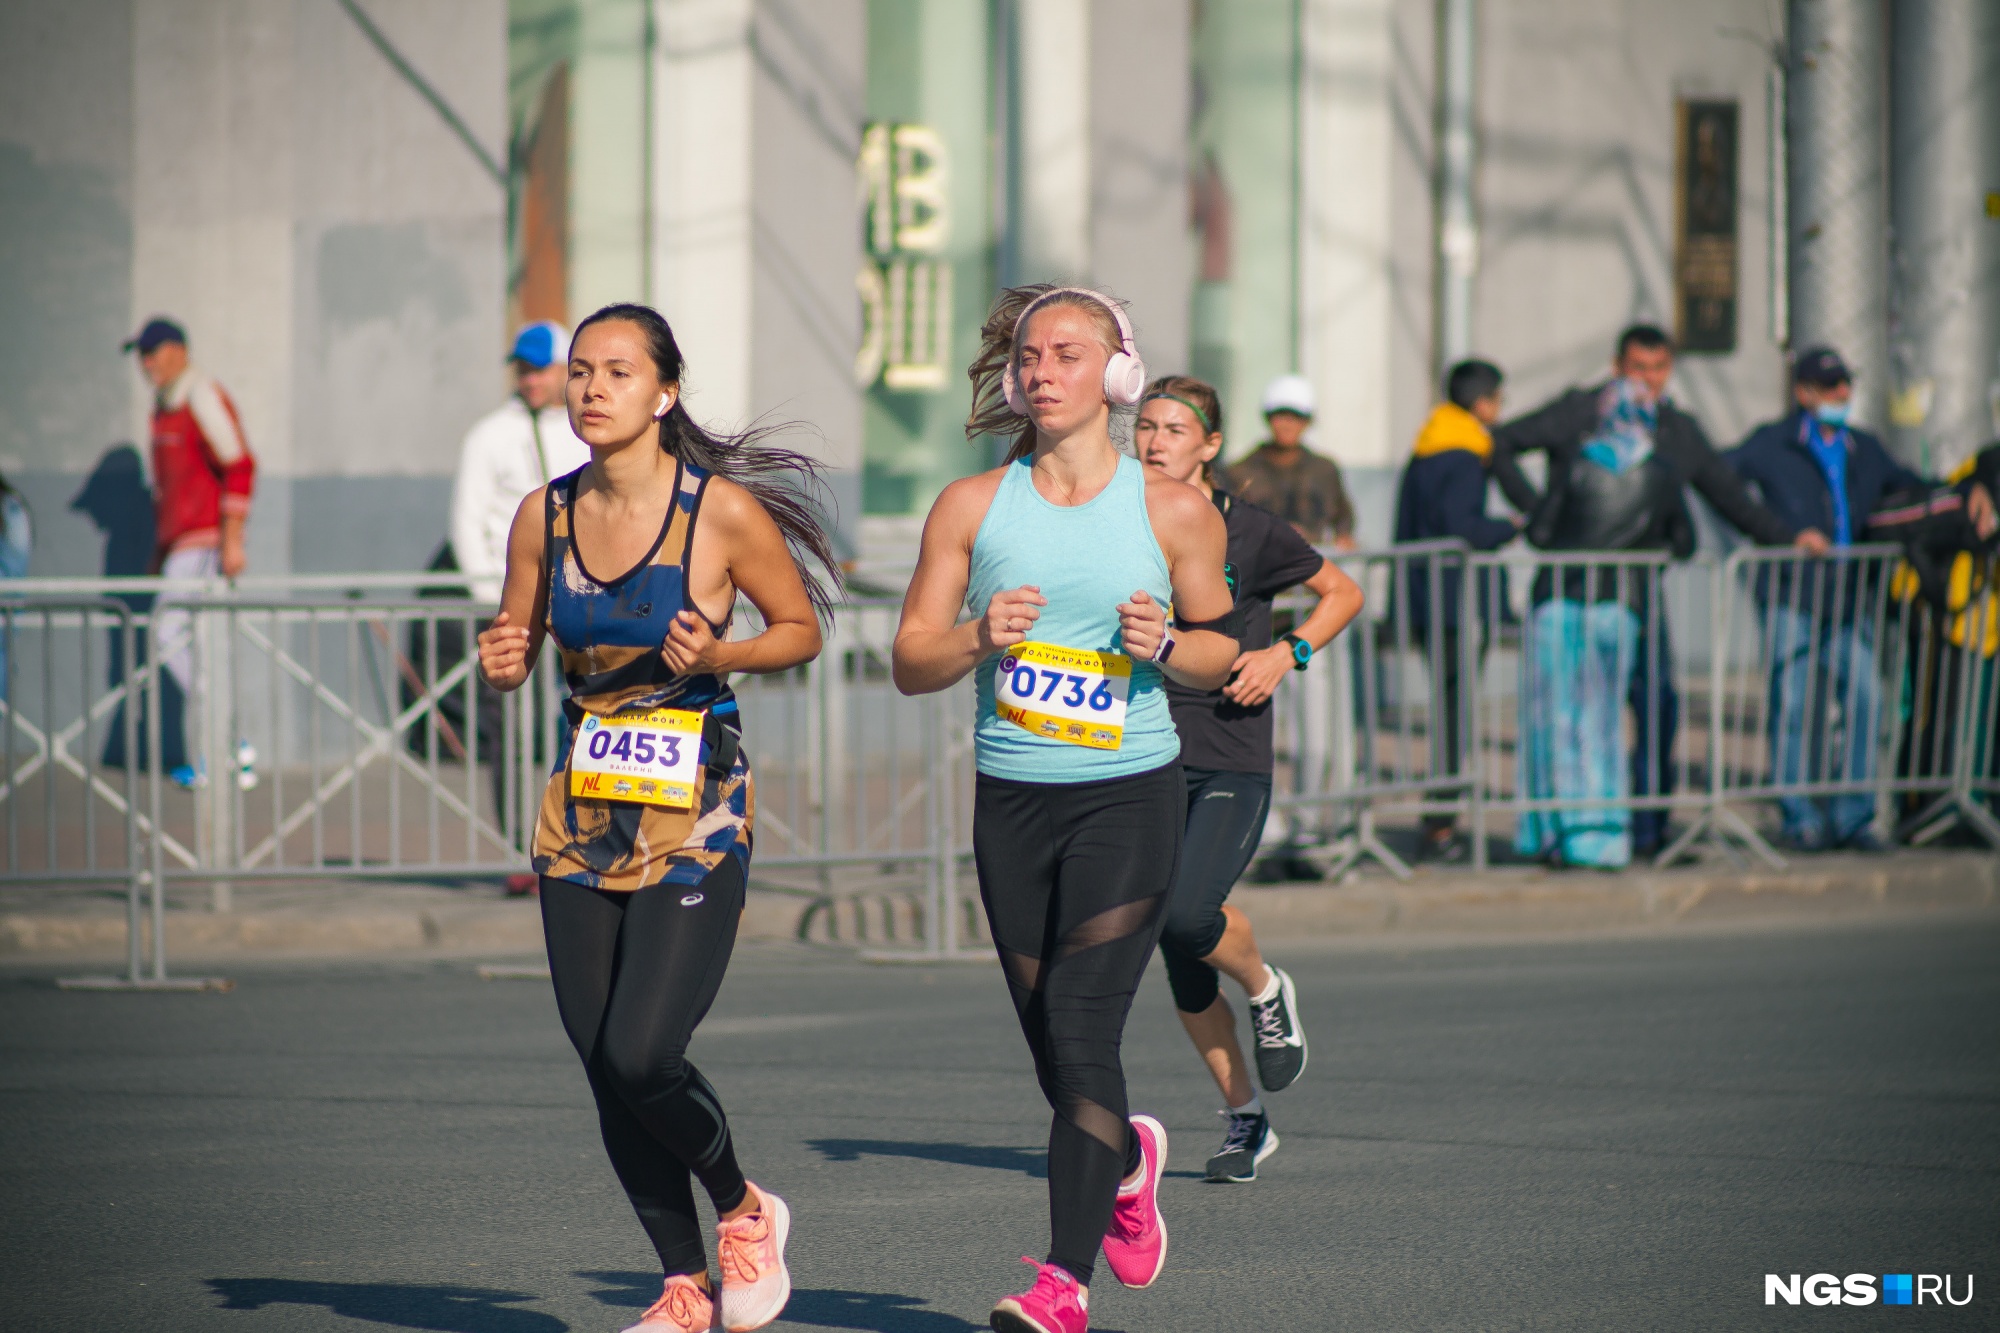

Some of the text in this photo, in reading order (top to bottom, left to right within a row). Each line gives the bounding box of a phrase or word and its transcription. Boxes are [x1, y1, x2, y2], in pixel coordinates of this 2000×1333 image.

[1012, 666, 1112, 711] 0736
[586, 719, 597, 730] D
[1006, 709, 1027, 726] NL
[589, 730, 682, 767] 0453
[580, 772, 602, 795] NL
